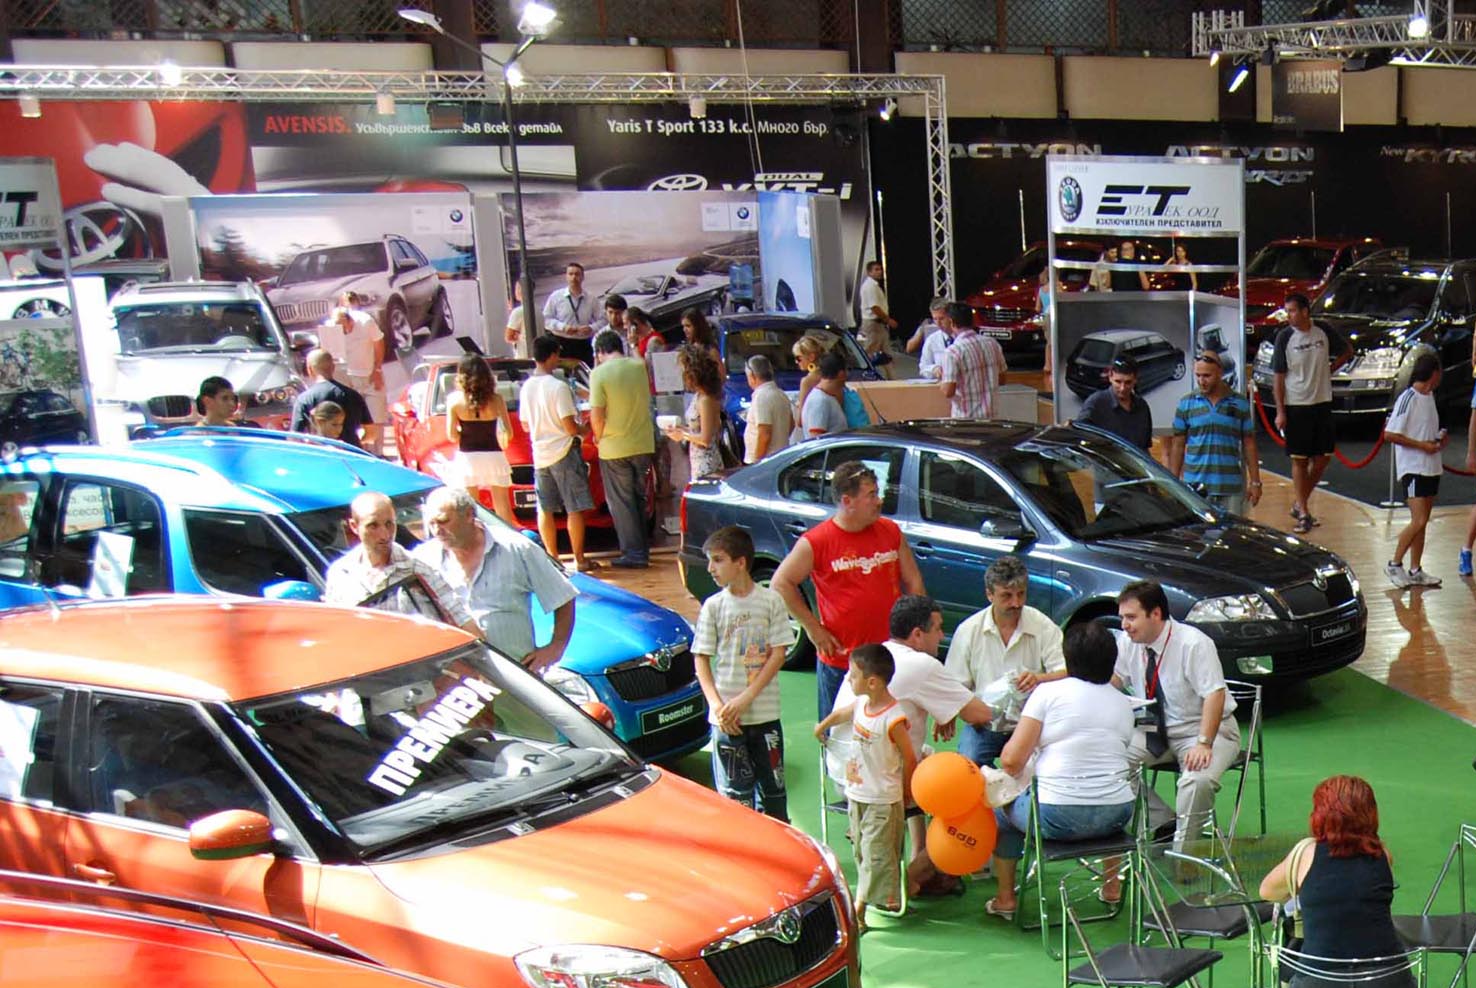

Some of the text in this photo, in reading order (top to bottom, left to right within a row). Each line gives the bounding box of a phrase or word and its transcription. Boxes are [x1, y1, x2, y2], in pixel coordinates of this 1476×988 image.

[484, 121, 517, 134] всек
[607, 119, 641, 134] Yaris
[645, 120, 654, 133] T
[657, 120, 694, 138] Sport
[699, 120, 725, 134] 133
[758, 120, 800, 135] Много
[1096, 218, 1223, 229] ИЗКЛЮЧИТЕЛЕН ПРЕДСТАВИТЕЛ
[658, 704, 694, 724] Roomster
[367, 676, 502, 797] ПРЕМИЕРА
